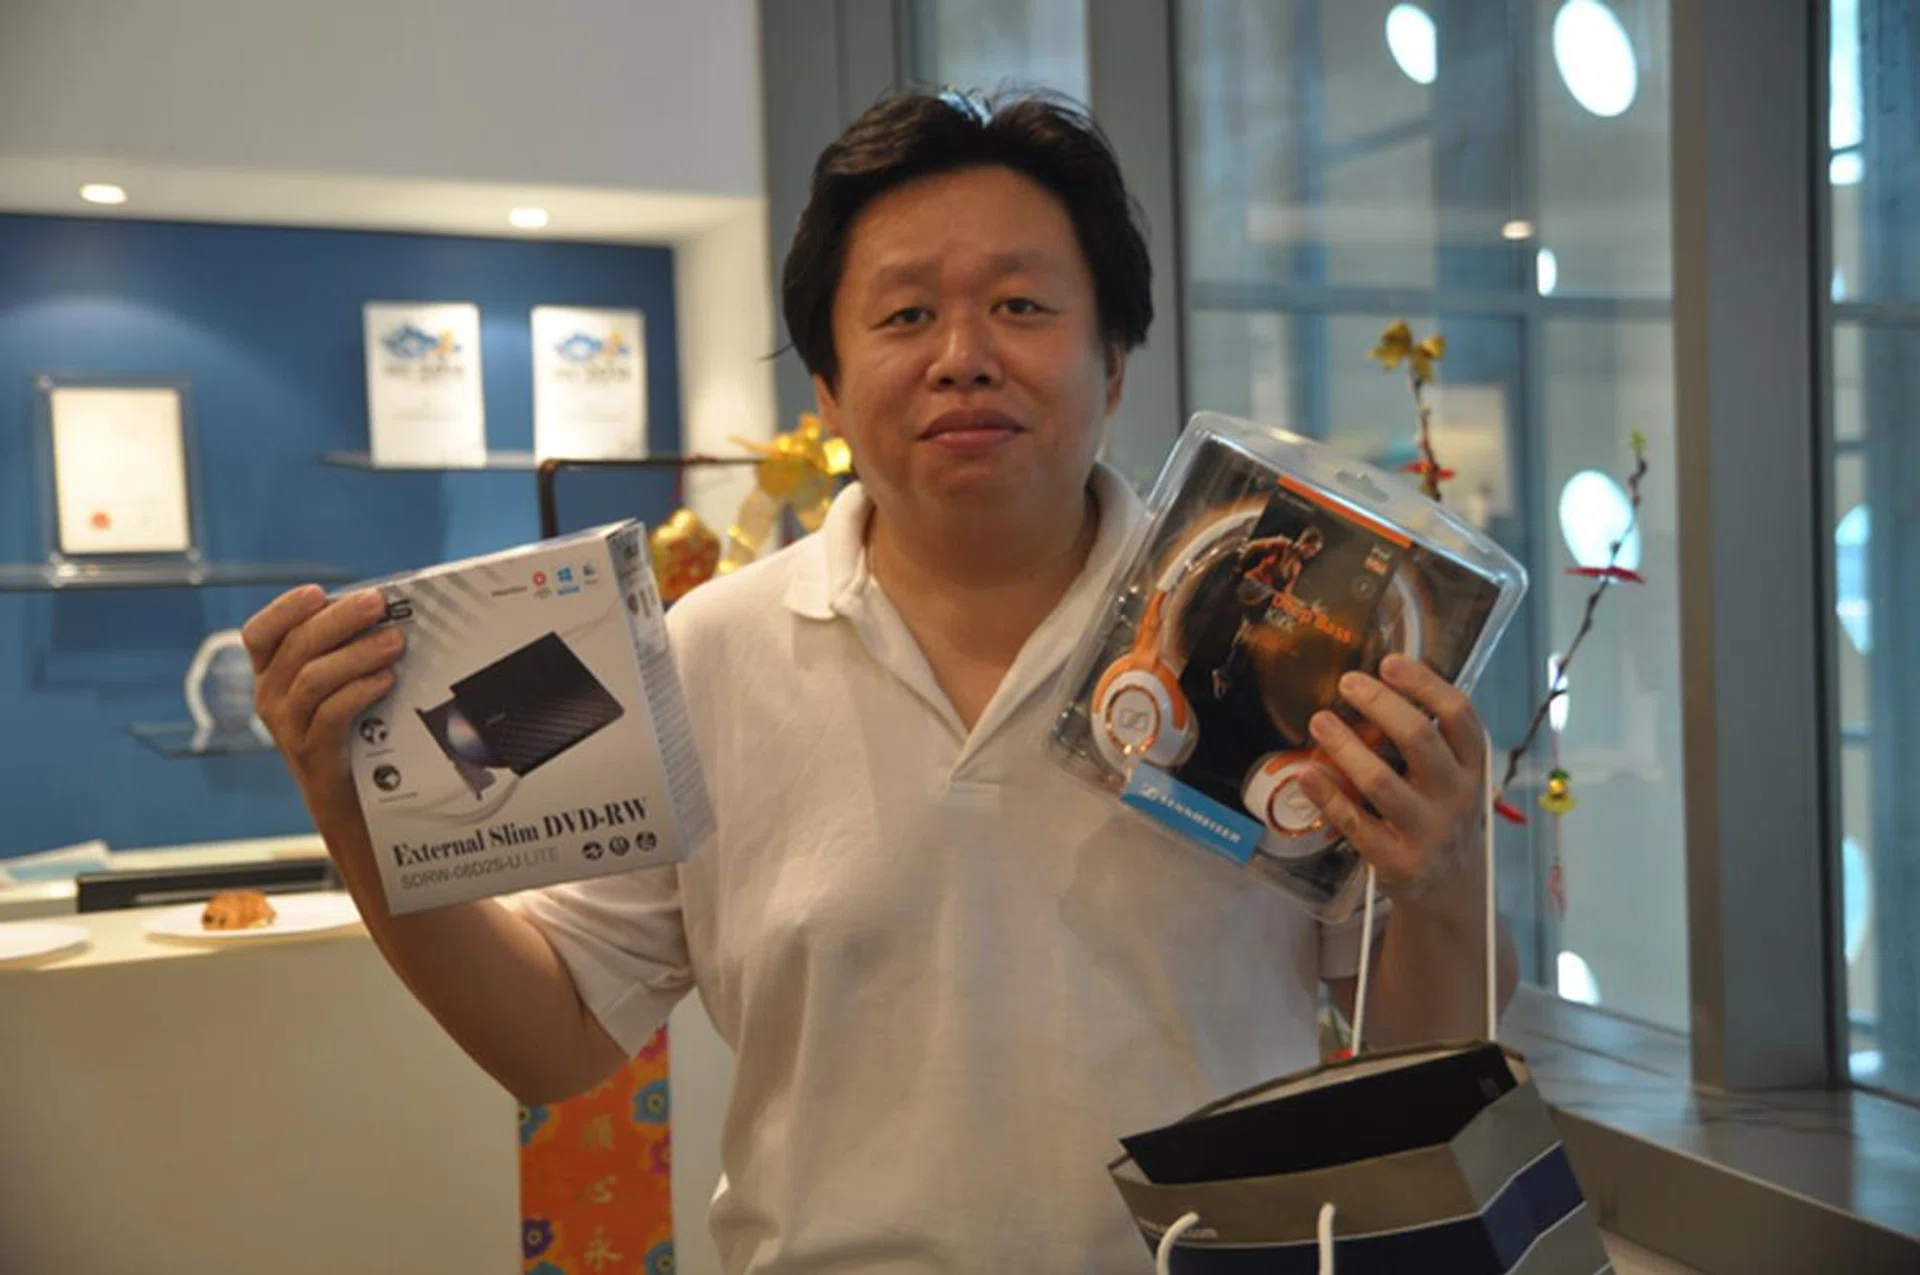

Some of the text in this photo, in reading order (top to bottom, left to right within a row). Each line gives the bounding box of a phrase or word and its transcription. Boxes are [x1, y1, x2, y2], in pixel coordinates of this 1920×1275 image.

[392, 797, 648, 868] External Slim DVD-RW
[522, 847, 562, 870] LITE
